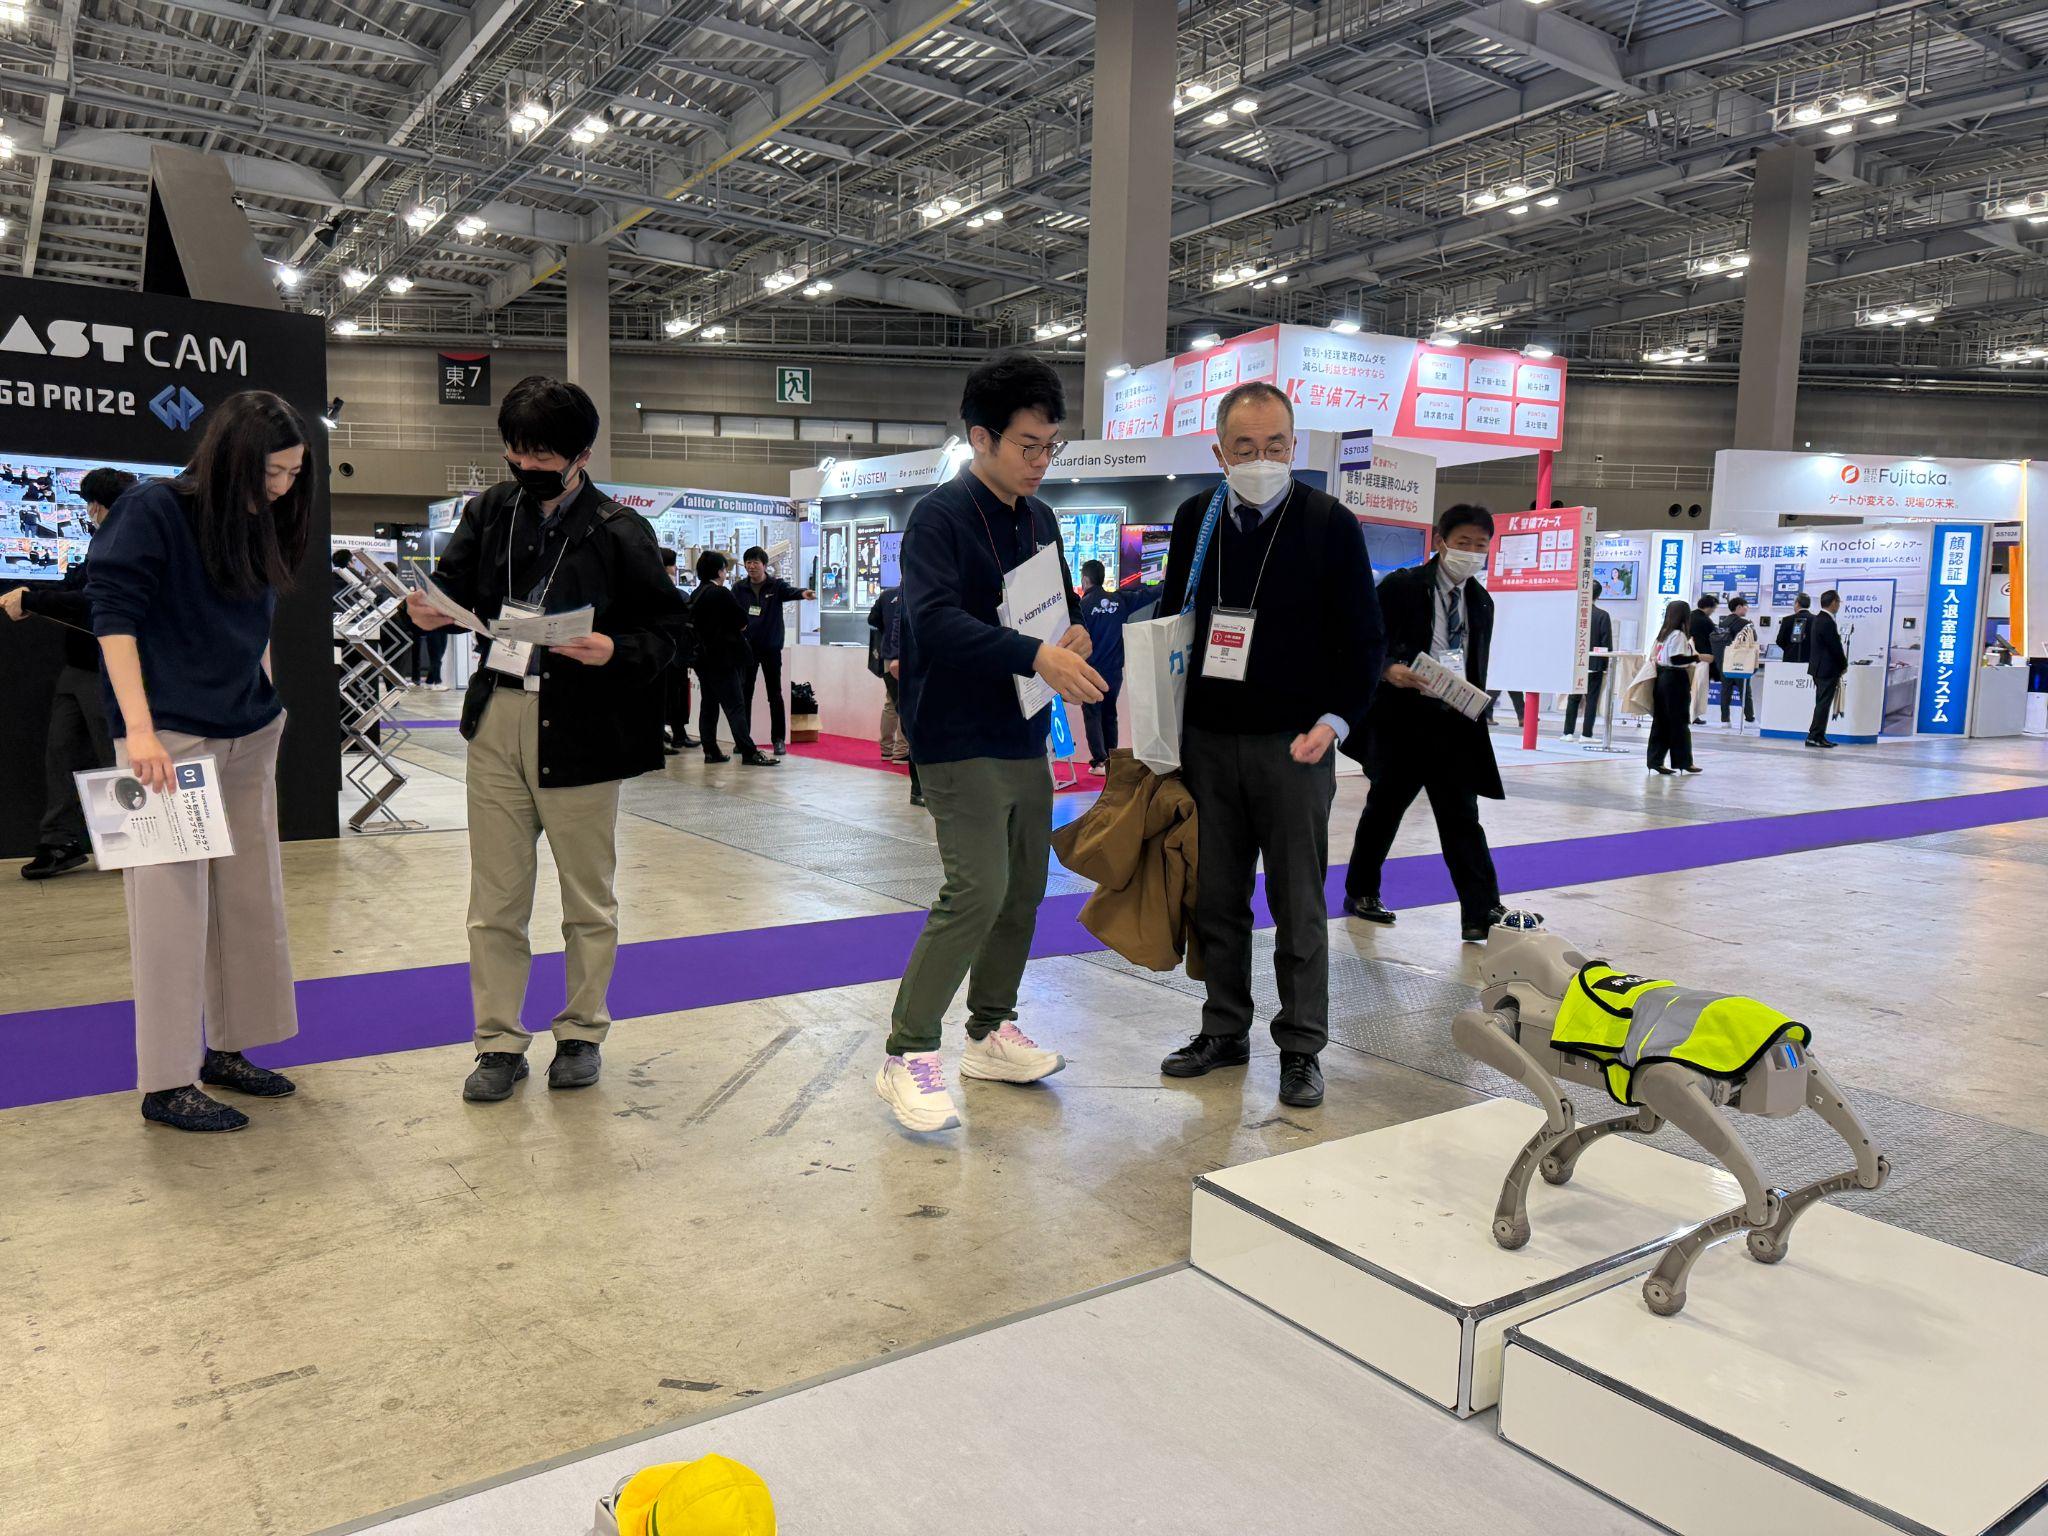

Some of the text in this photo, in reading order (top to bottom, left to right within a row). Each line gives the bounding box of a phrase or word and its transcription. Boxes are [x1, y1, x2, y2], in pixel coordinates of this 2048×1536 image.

[144, 330, 248, 377] CAM
[1309, 384, 1390, 411] 警備フォース
[1052, 454, 1146, 467] Guardian System
[1344, 446, 1369, 455] SS7035
[718, 498, 774, 515] Technology
[776, 503, 795, 516] Inc.
[1701, 540, 1742, 555] 日本製
[1947, 536, 1966, 581] 顔認証
[1662, 543, 1679, 592] 重要物品
[1932, 589, 1960, 723] 入退室管理システム
[183, 769, 196, 783] 01
